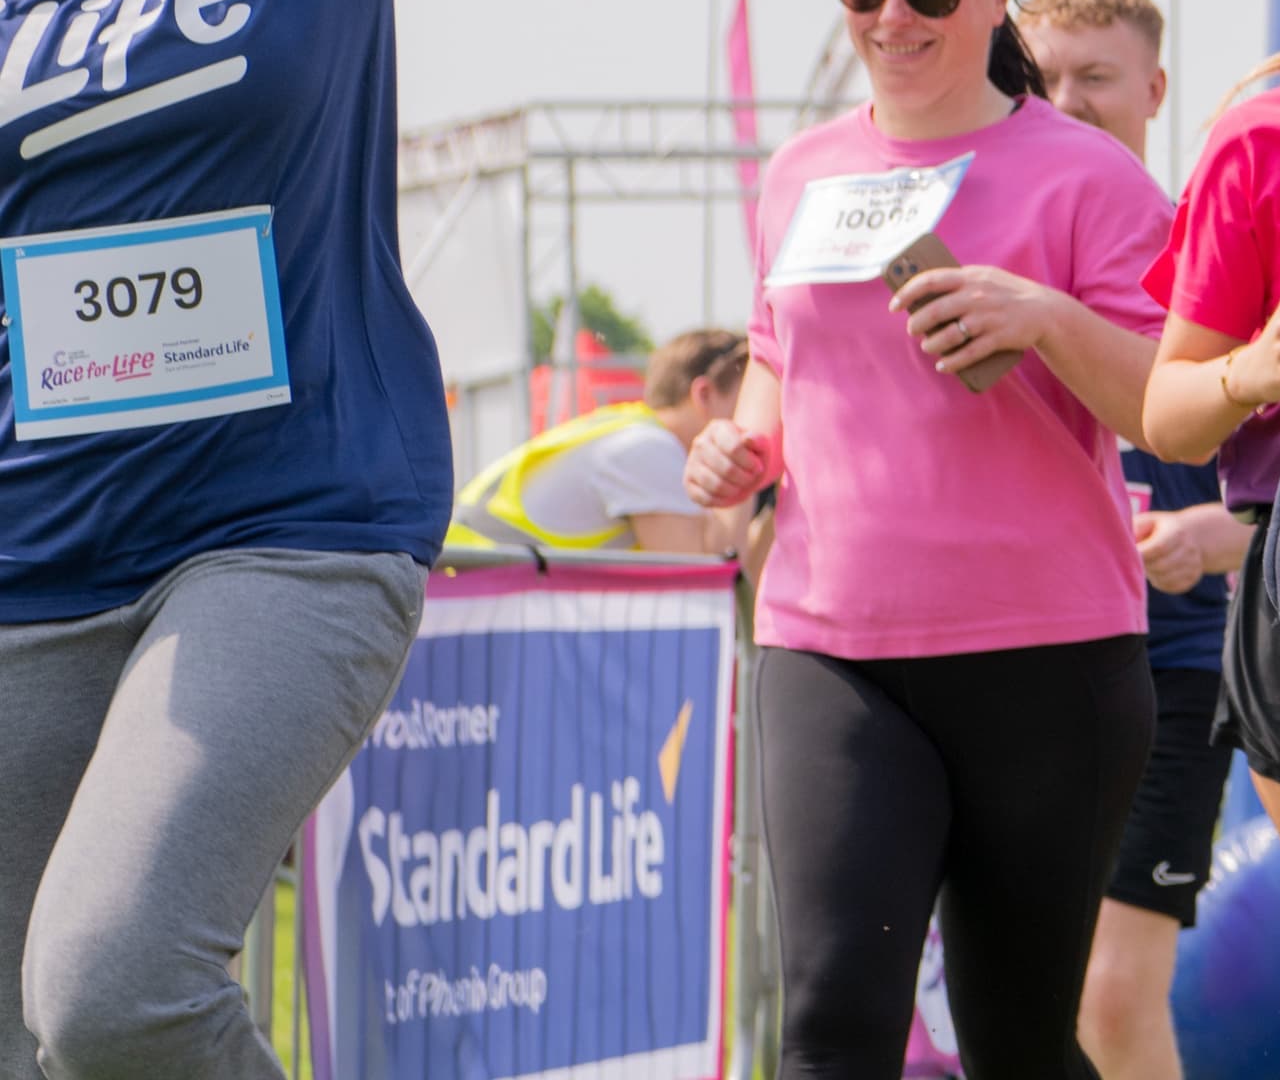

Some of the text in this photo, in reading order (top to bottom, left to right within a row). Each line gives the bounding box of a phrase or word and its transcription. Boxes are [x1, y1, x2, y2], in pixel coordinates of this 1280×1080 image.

[74, 267, 202, 322] 3079
[41, 364, 84, 390] Race
[87, 360, 111, 379] for
[112, 352, 155, 377] Life
[164, 339, 249, 364] Standard Life
[359, 777, 664, 927] Standard Life
